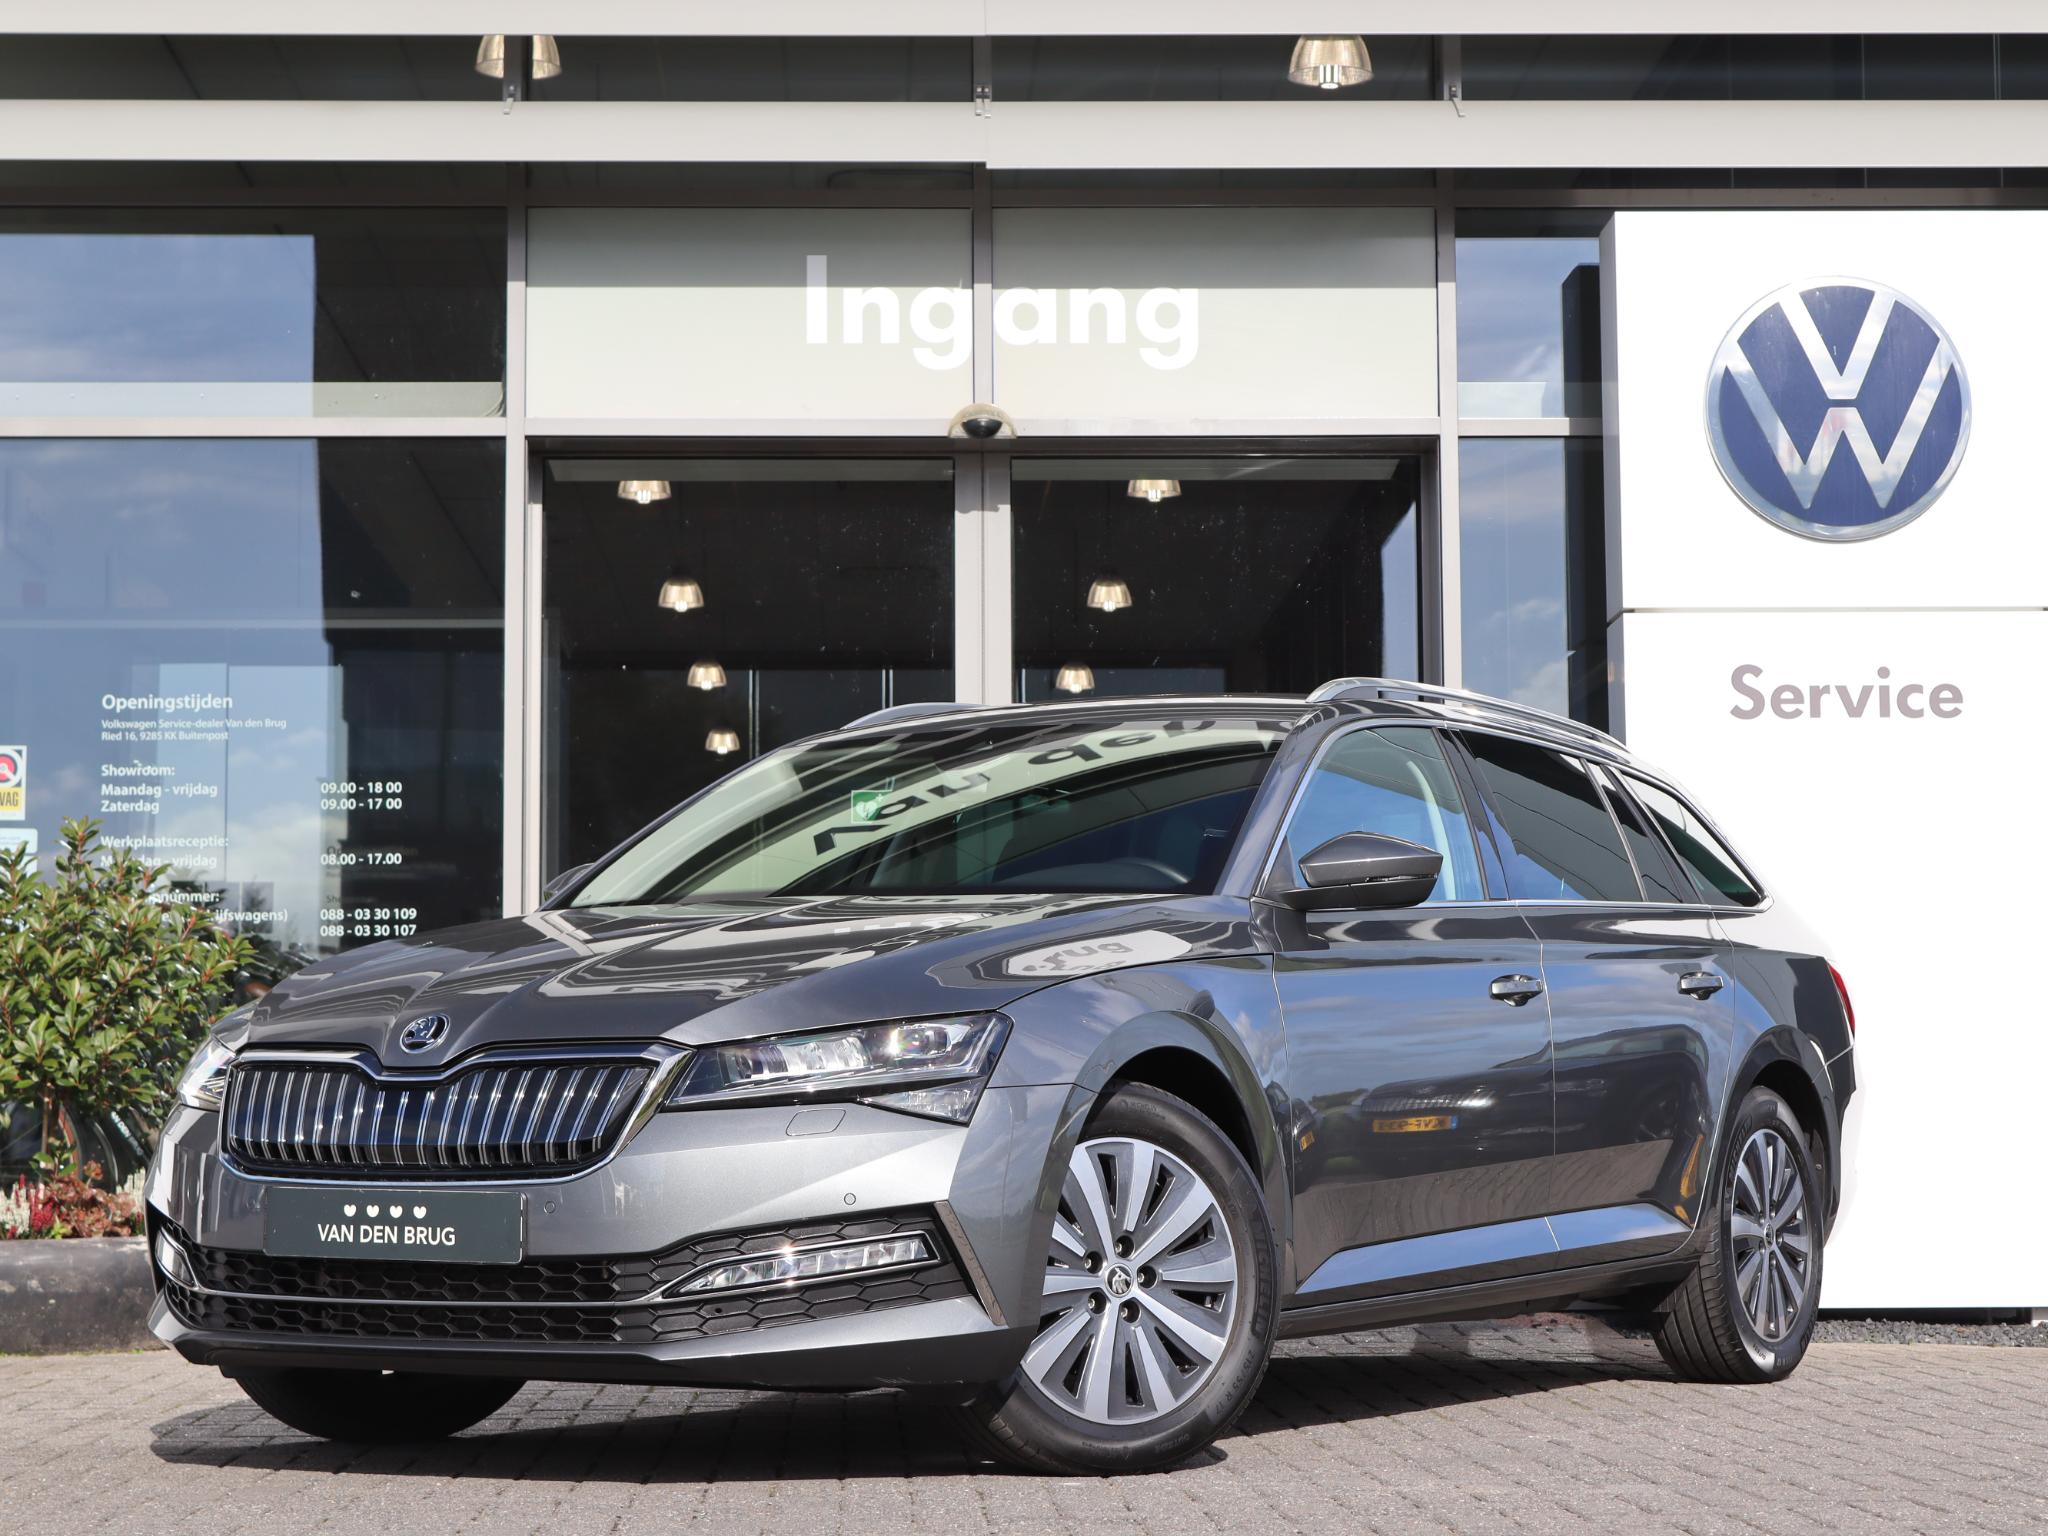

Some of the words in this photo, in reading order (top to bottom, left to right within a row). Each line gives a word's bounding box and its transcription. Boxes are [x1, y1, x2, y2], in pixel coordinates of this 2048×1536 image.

[807, 255, 1200, 370] Ingang
[1730, 664, 1963, 720] Service
[102, 693, 233, 712] Openingstijden
[101, 719, 156, 730] Volkswagen
[159, 718, 225, 729] Service-dealer
[225, 718, 243, 728] Van
[245, 718, 263, 728] den
[265, 718, 287, 730] Brug
[101, 731, 122, 741] Ried
[125, 732, 138, 742] 16,
[140, 731, 162, 741] 9285
[164, 731, 177, 741] KK
[179, 731, 228, 742] Buitenpost
[101, 764, 175, 777] Showroom:
[101, 783, 162, 798] Maandag
[172, 783, 218, 798] vrijdag
[320, 782, 357, 794] 09.00
[101, 799, 160, 814] Zaterdag
[320, 798, 357, 810] 09.00
[101, 835, 229, 850] Werkplaatsreceptie:
[172, 854, 218, 869] vrijdag
[320, 853, 357, 865] 08.00
[367, 852, 403, 865] 17.00
[320, 908, 344, 920] 088
[354, 908, 371, 920] 03
[373, 908, 390, 920] 30
[393, 908, 417, 920] 109
[320, 925, 344, 937] 088
[354, 924, 371, 936] 03
[373, 924, 390, 936] 30
[393, 924, 417, 936] 107
[318, 1223, 354, 1243] VAN
[360, 1225, 398, 1244] DEN
[404, 1226, 456, 1246] BRUG
